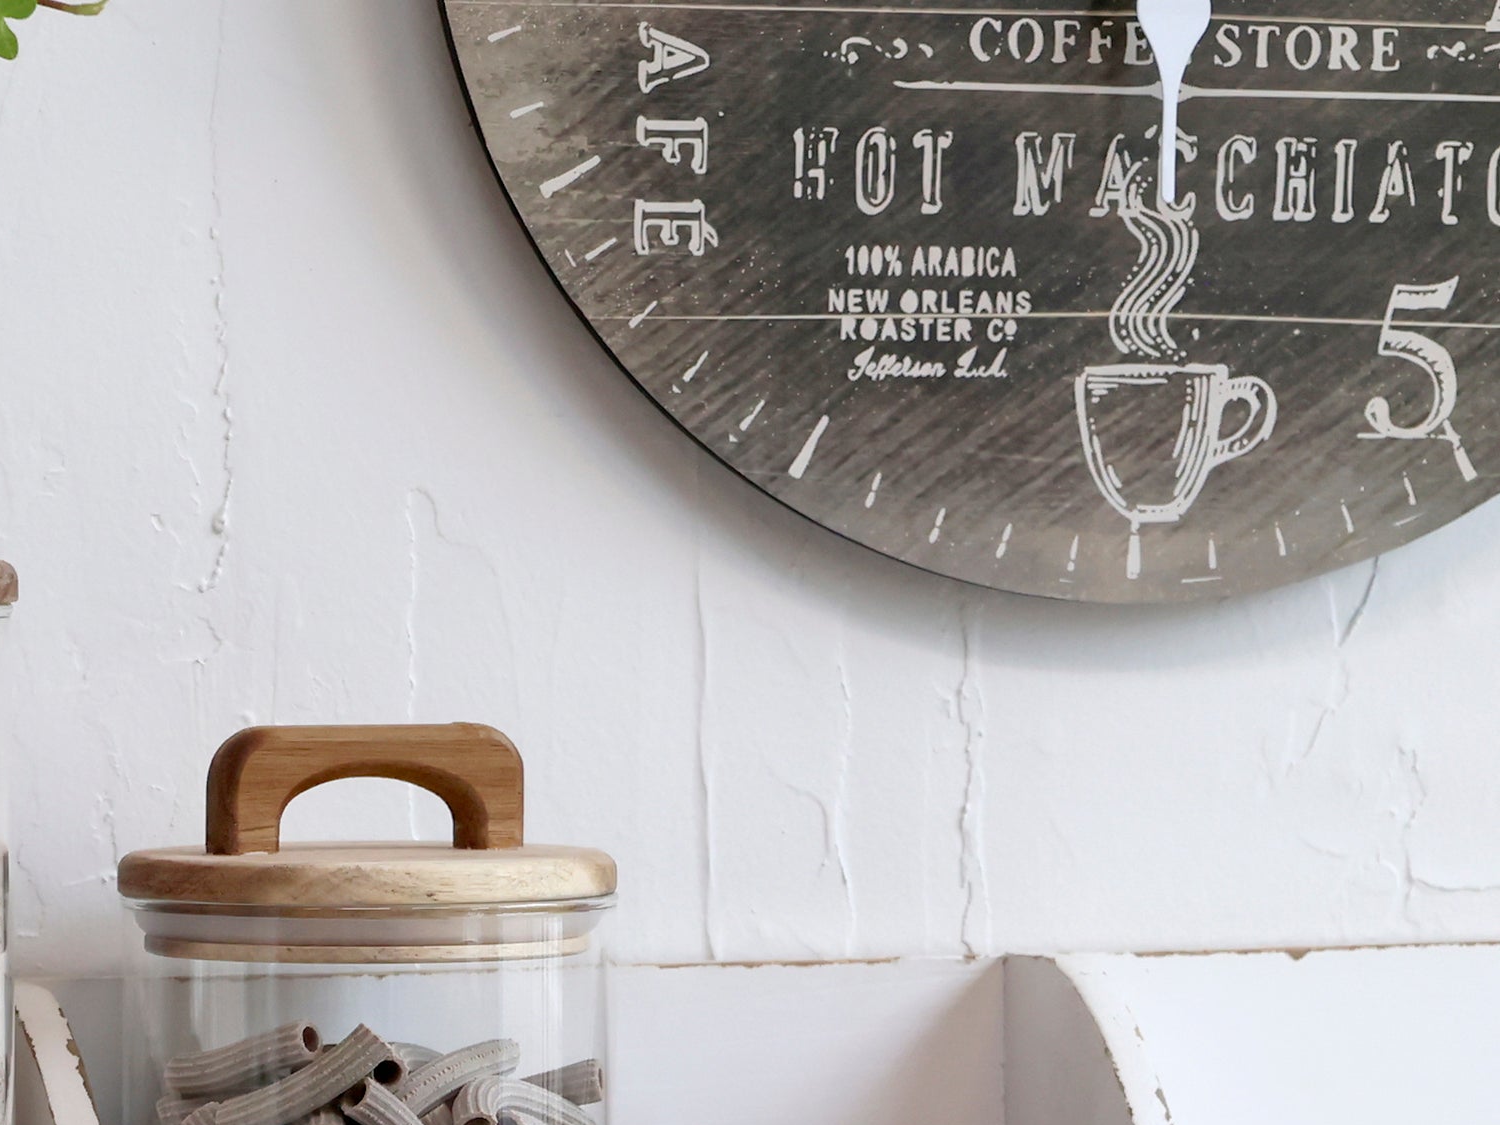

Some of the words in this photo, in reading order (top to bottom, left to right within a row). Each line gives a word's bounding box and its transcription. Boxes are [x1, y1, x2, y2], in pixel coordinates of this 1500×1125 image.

[968, 17, 1193, 66] COFFE
[1213, 23, 1401, 72] STORE
[792, 125, 955, 216] HOT
[844, 244, 903, 277] 100%
[910, 245, 1018, 279] ARABICA
[827, 287, 890, 314] NEW
[899, 288, 1033, 315] ORLEANS
[839, 316, 973, 343] ROASTER
[847, 345, 948, 382] Jefferson
[1362, 276, 1460, 439] 5
